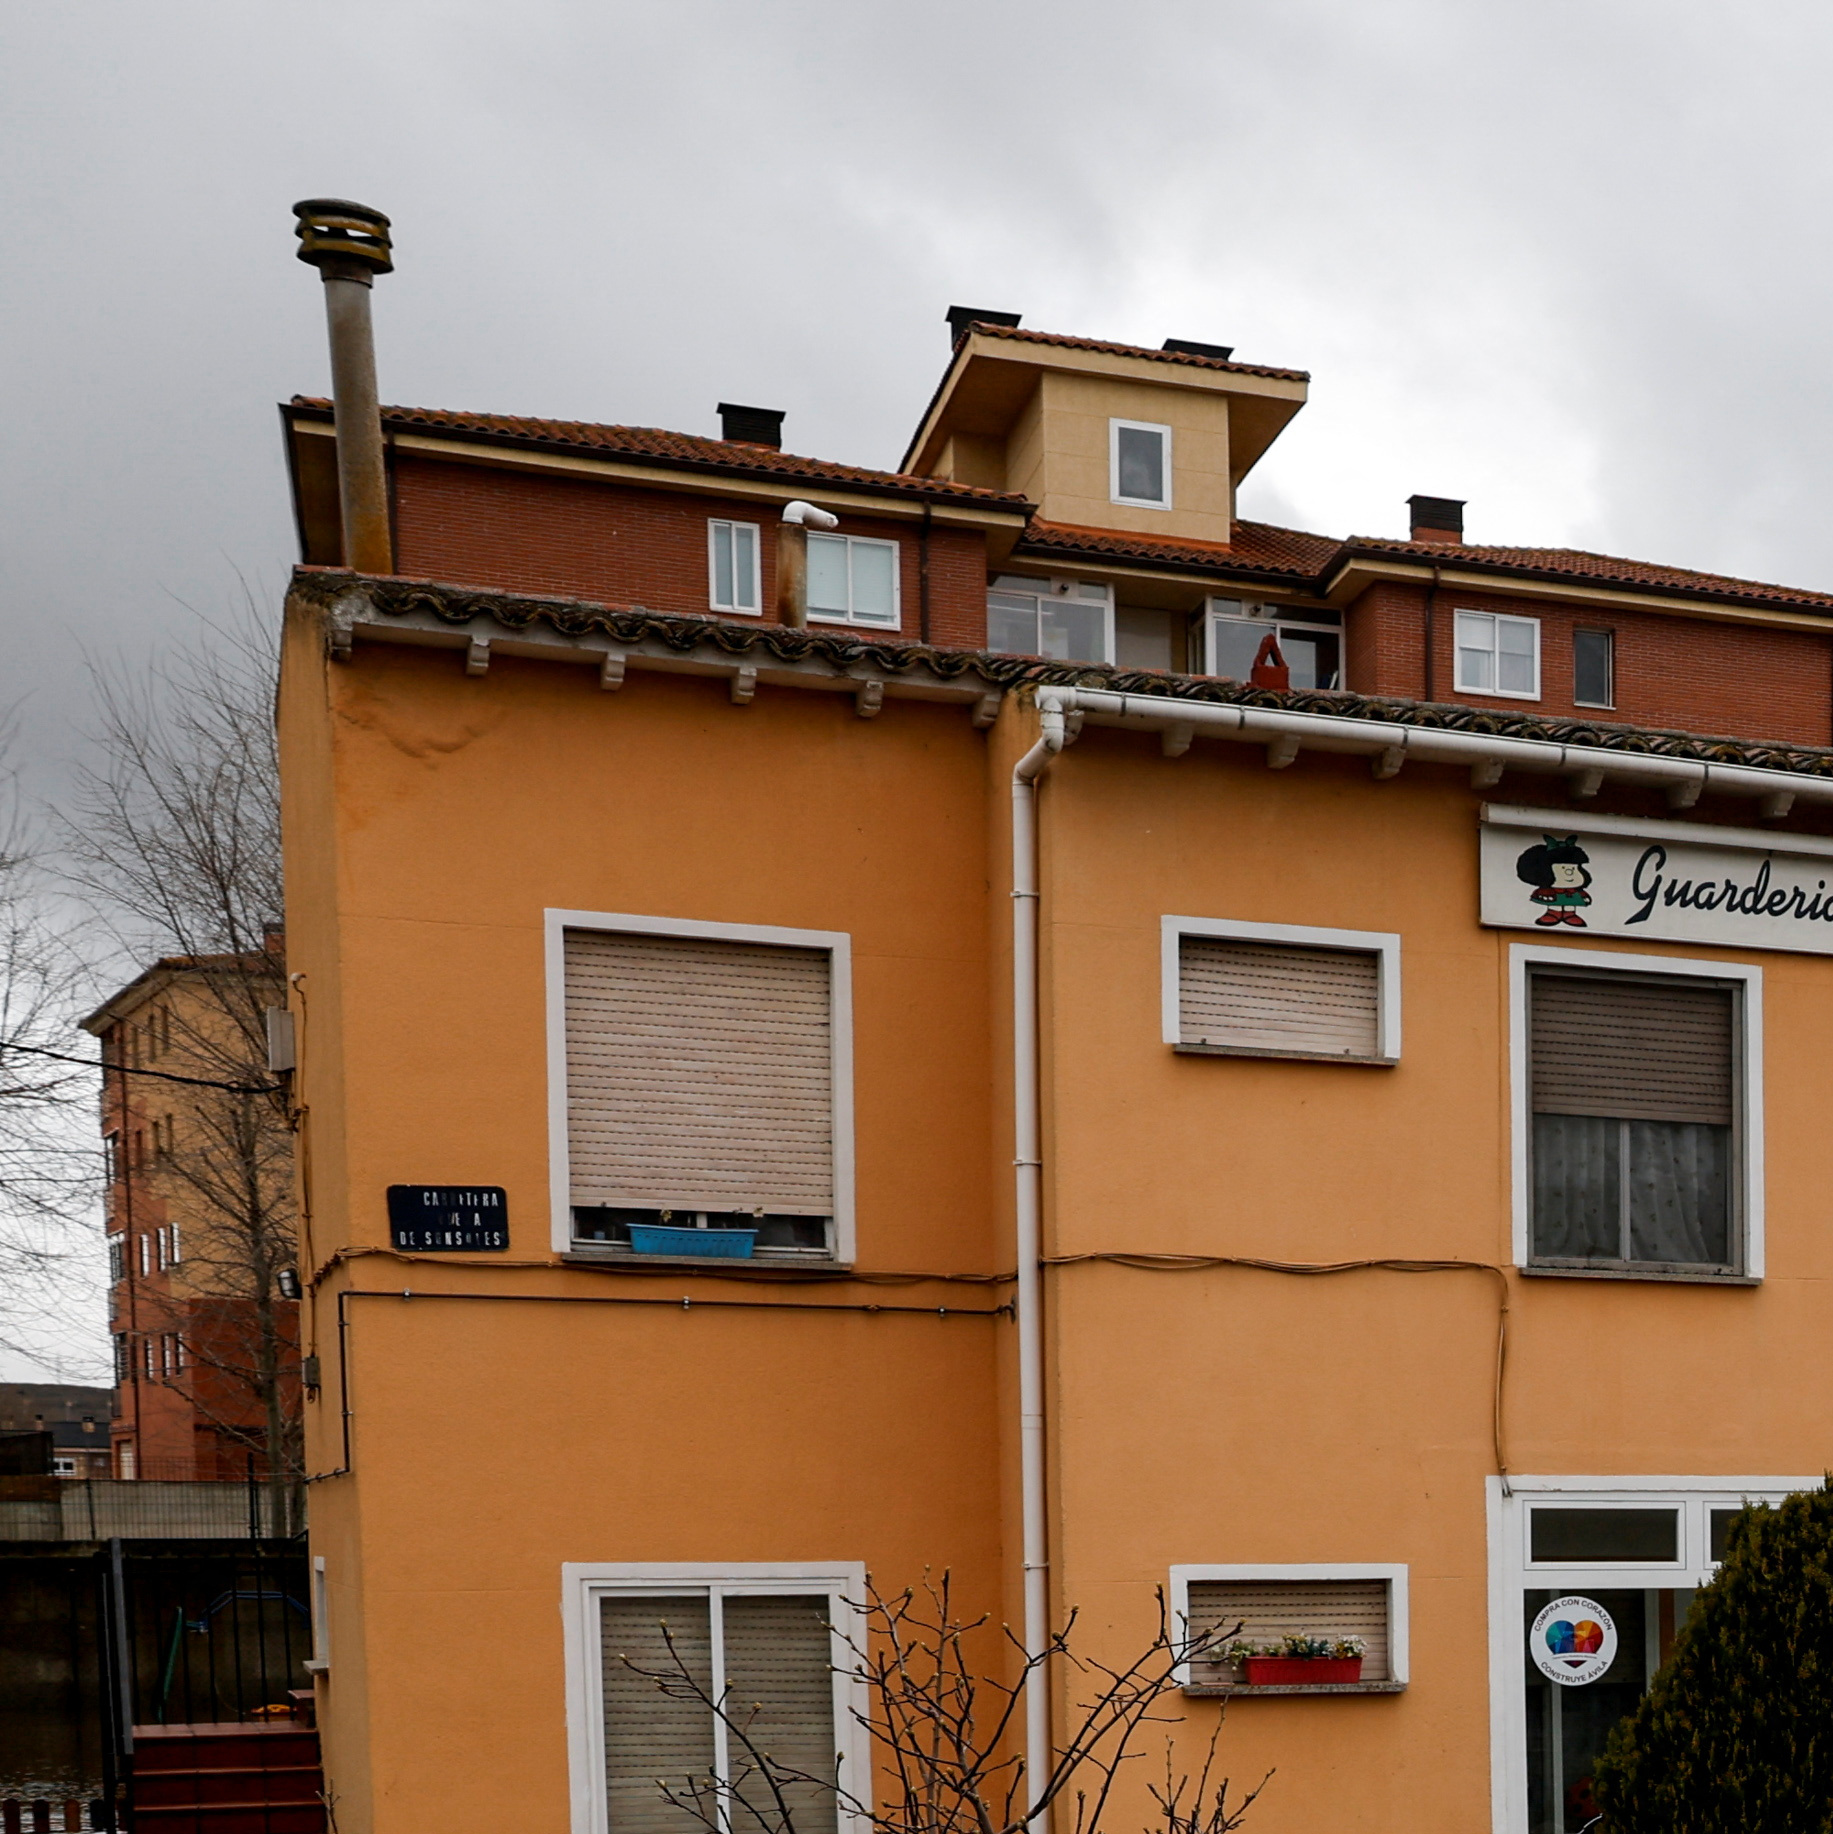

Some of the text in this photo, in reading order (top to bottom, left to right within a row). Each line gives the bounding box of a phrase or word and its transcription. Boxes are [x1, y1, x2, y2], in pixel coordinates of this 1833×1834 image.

[423, 1191, 499, 1207] CARETERA
[399, 1231, 415, 1245] DE
[1534, 1603, 1561, 1632] COMPRA
[1561, 1599, 1580, 1607] CON
[1541, 1661, 1586, 1683] CONSTRUYE
